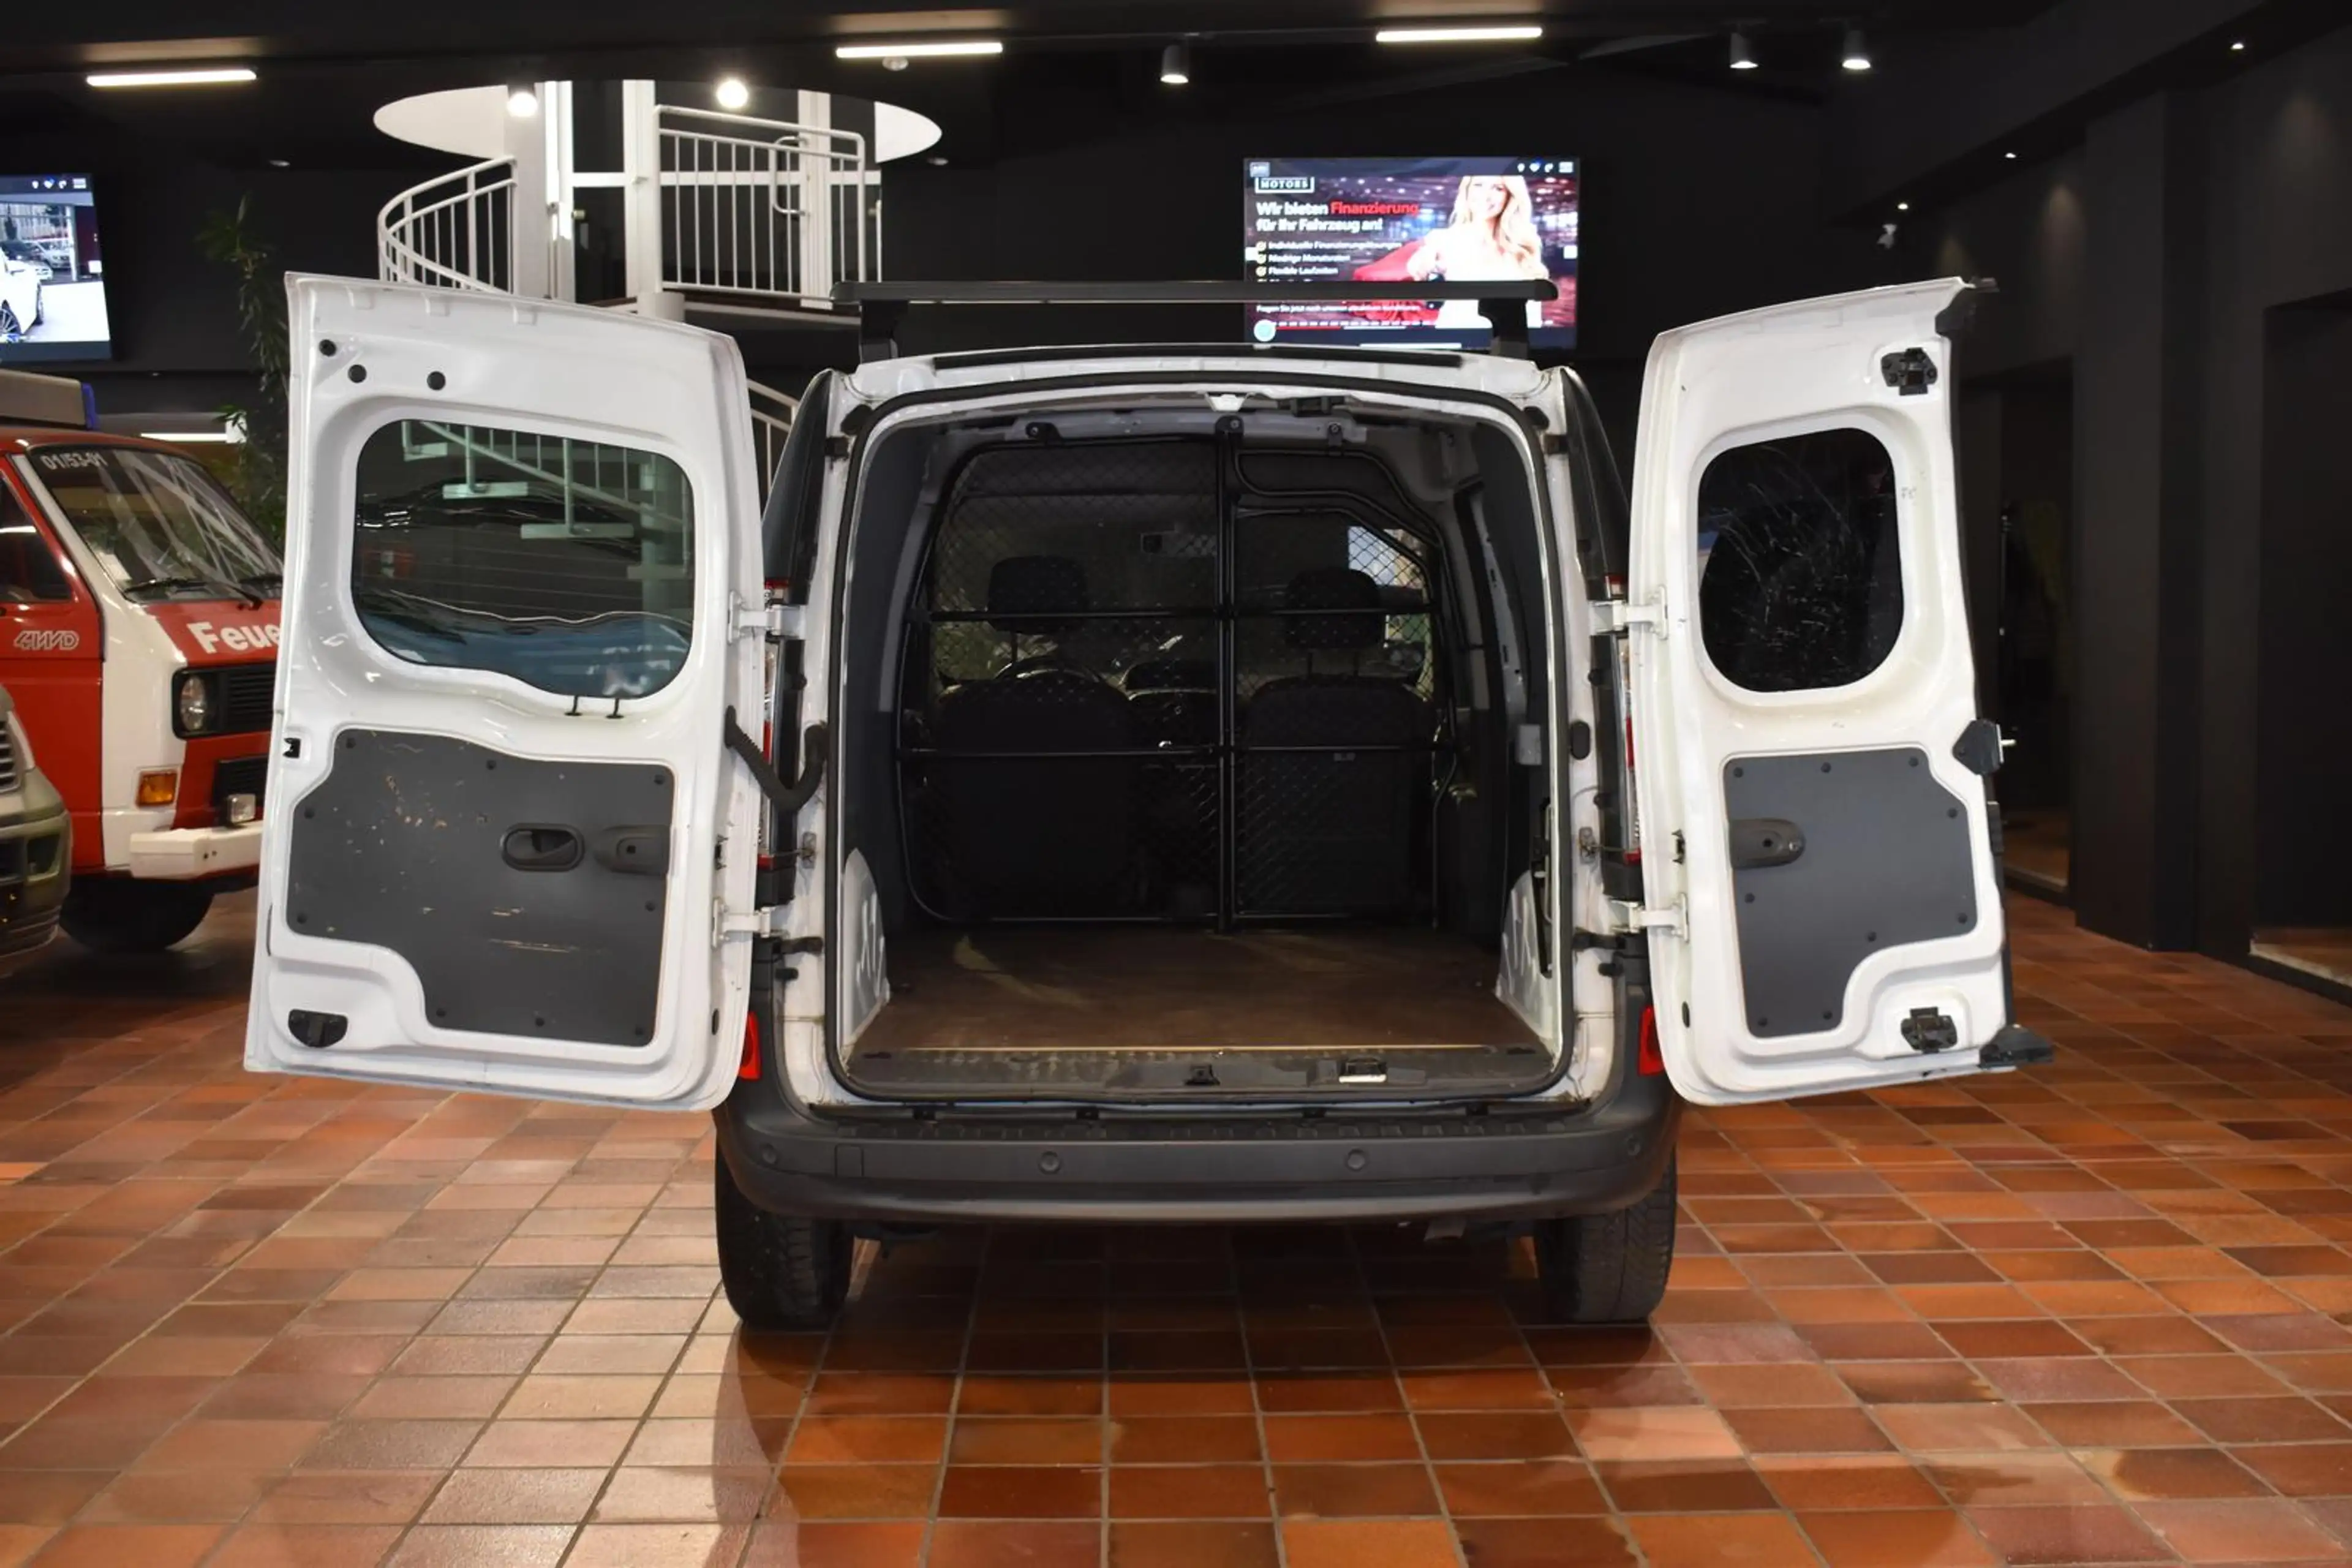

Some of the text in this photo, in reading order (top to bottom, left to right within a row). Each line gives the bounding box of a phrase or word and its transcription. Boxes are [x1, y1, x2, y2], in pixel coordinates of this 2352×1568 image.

[1256, 201, 1420, 217] Wir bieten Finanzierung
[1257, 218, 1277, 232] für
[1299, 218, 1360, 233] Fahrzeug
[13, 630, 80, 650] 4WD
